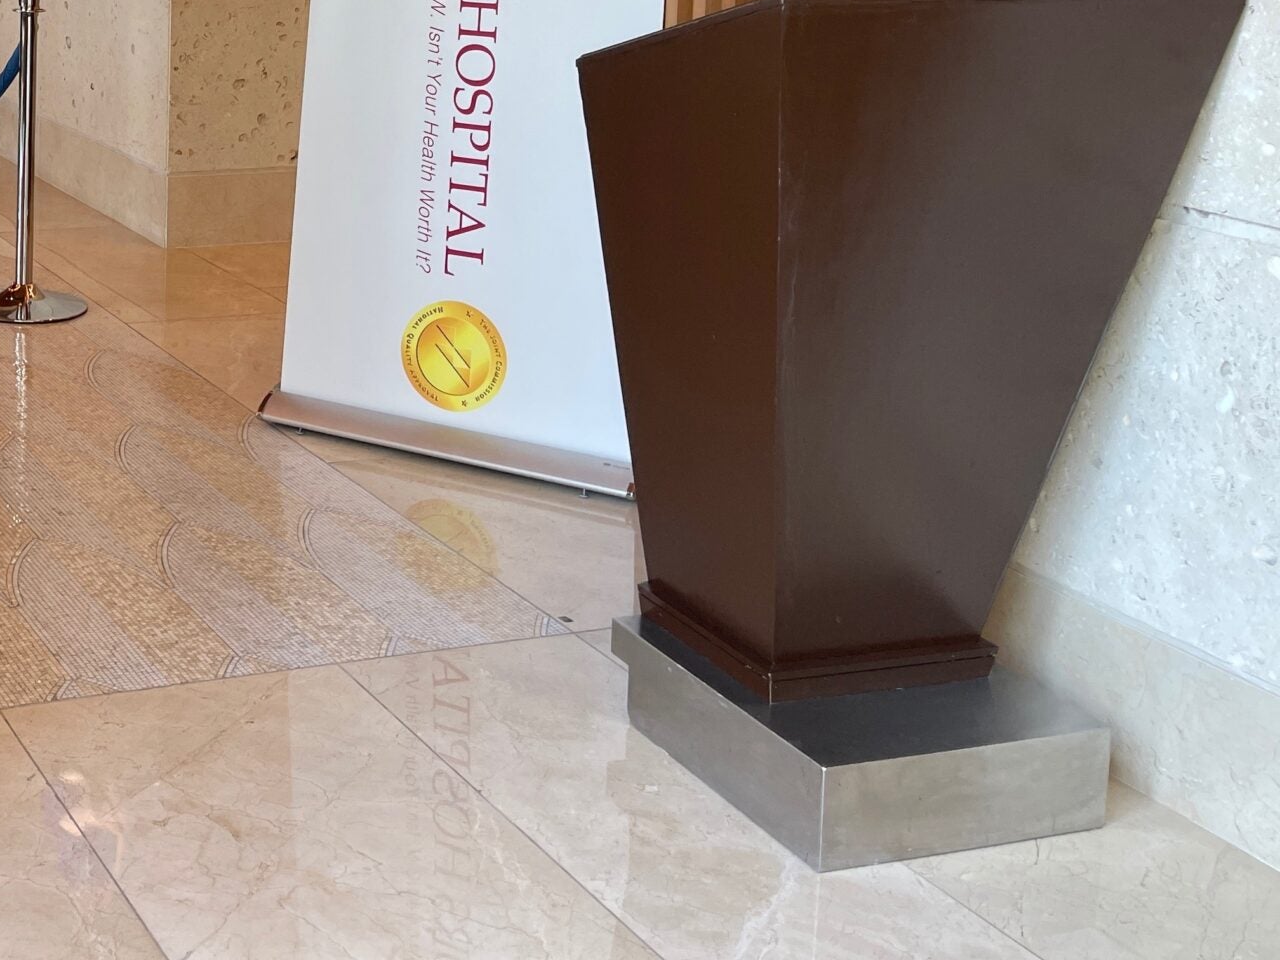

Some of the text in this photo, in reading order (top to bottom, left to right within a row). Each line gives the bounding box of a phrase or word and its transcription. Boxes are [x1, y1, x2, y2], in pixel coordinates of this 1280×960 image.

[427, 25, 445, 65] Isn't
[424, 73, 442, 116] Your
[421, 120, 439, 183] Health
[417, 190, 435, 243] Worth
[415, 247, 432, 275] It?
